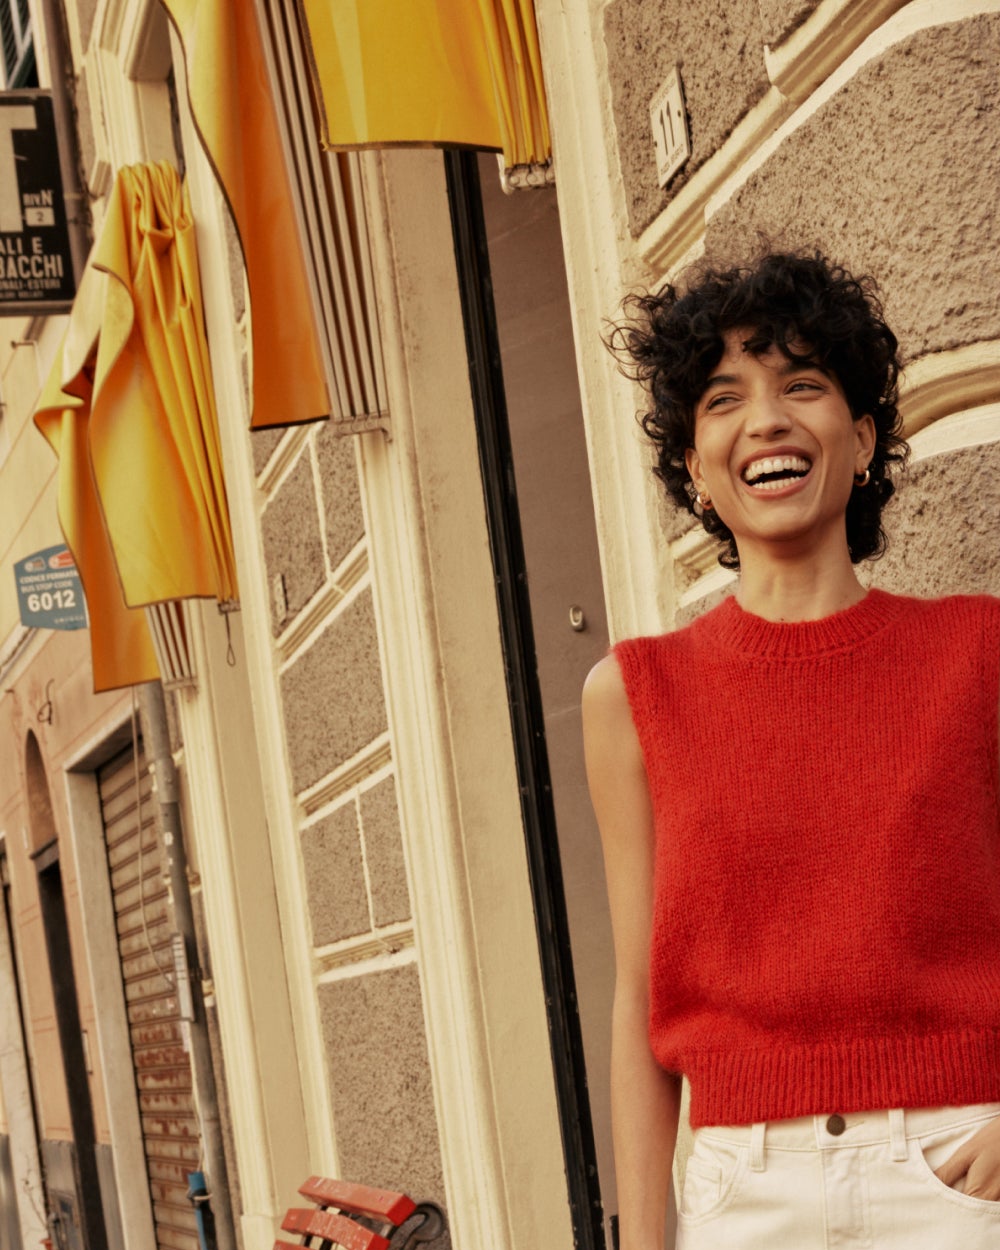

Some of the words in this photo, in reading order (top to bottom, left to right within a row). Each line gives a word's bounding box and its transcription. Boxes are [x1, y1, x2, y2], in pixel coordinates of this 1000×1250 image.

[660, 101, 675, 155] 11
[31, 236, 43, 254] E
[28, 589, 76, 612] 6012
